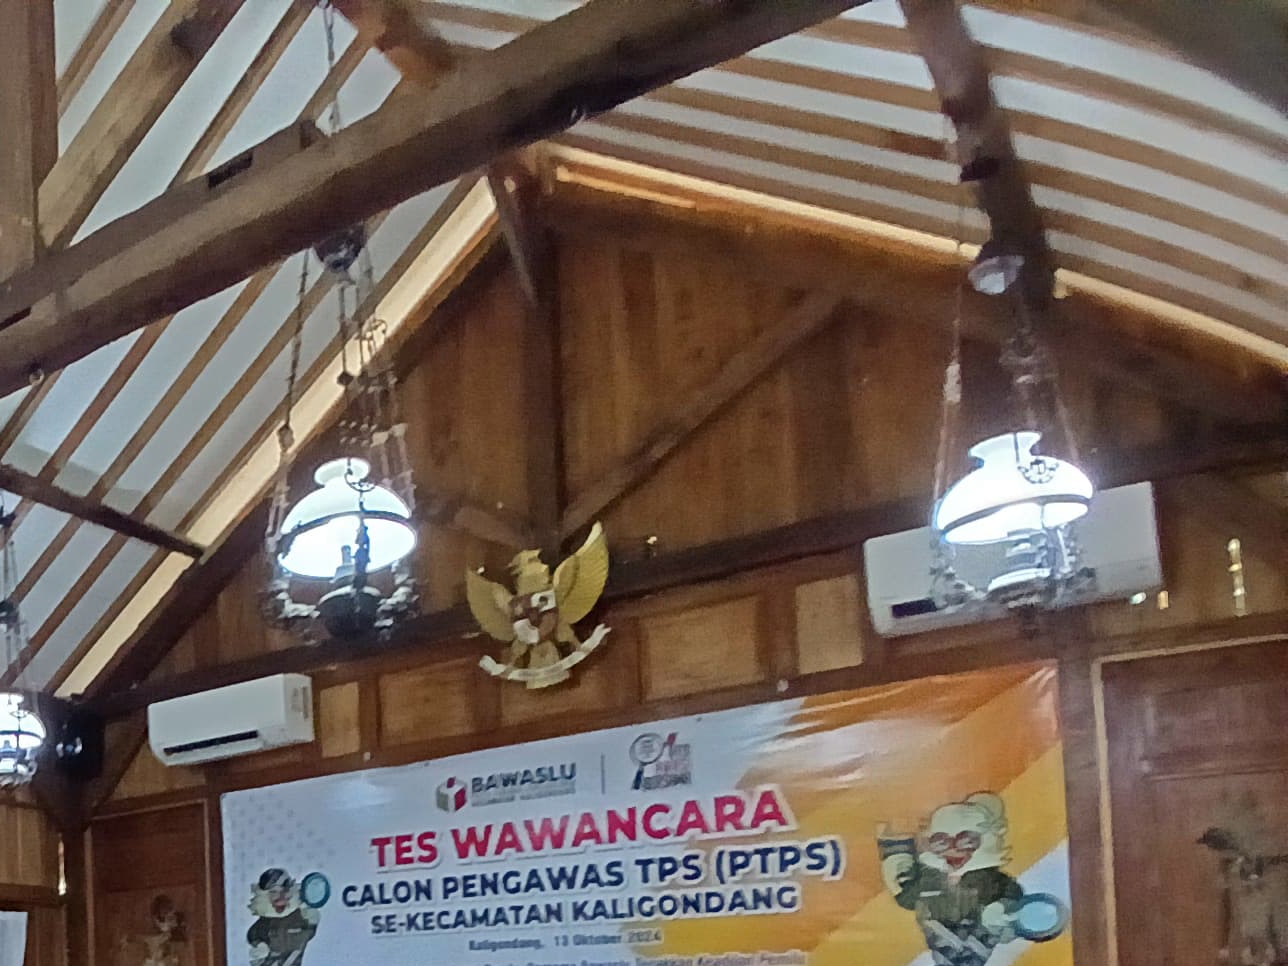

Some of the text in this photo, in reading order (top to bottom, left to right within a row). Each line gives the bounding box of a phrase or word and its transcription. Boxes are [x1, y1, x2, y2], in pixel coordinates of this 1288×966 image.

[471, 763, 577, 793] BAWASLU
[371, 831, 439, 867] TES
[450, 790, 788, 859] WAWANCARA
[342, 839, 841, 907] CALON PENGAWAS TPS (PTPS)
[371, 886, 798, 934] SE-KECAMATAN KALIGONDANG
